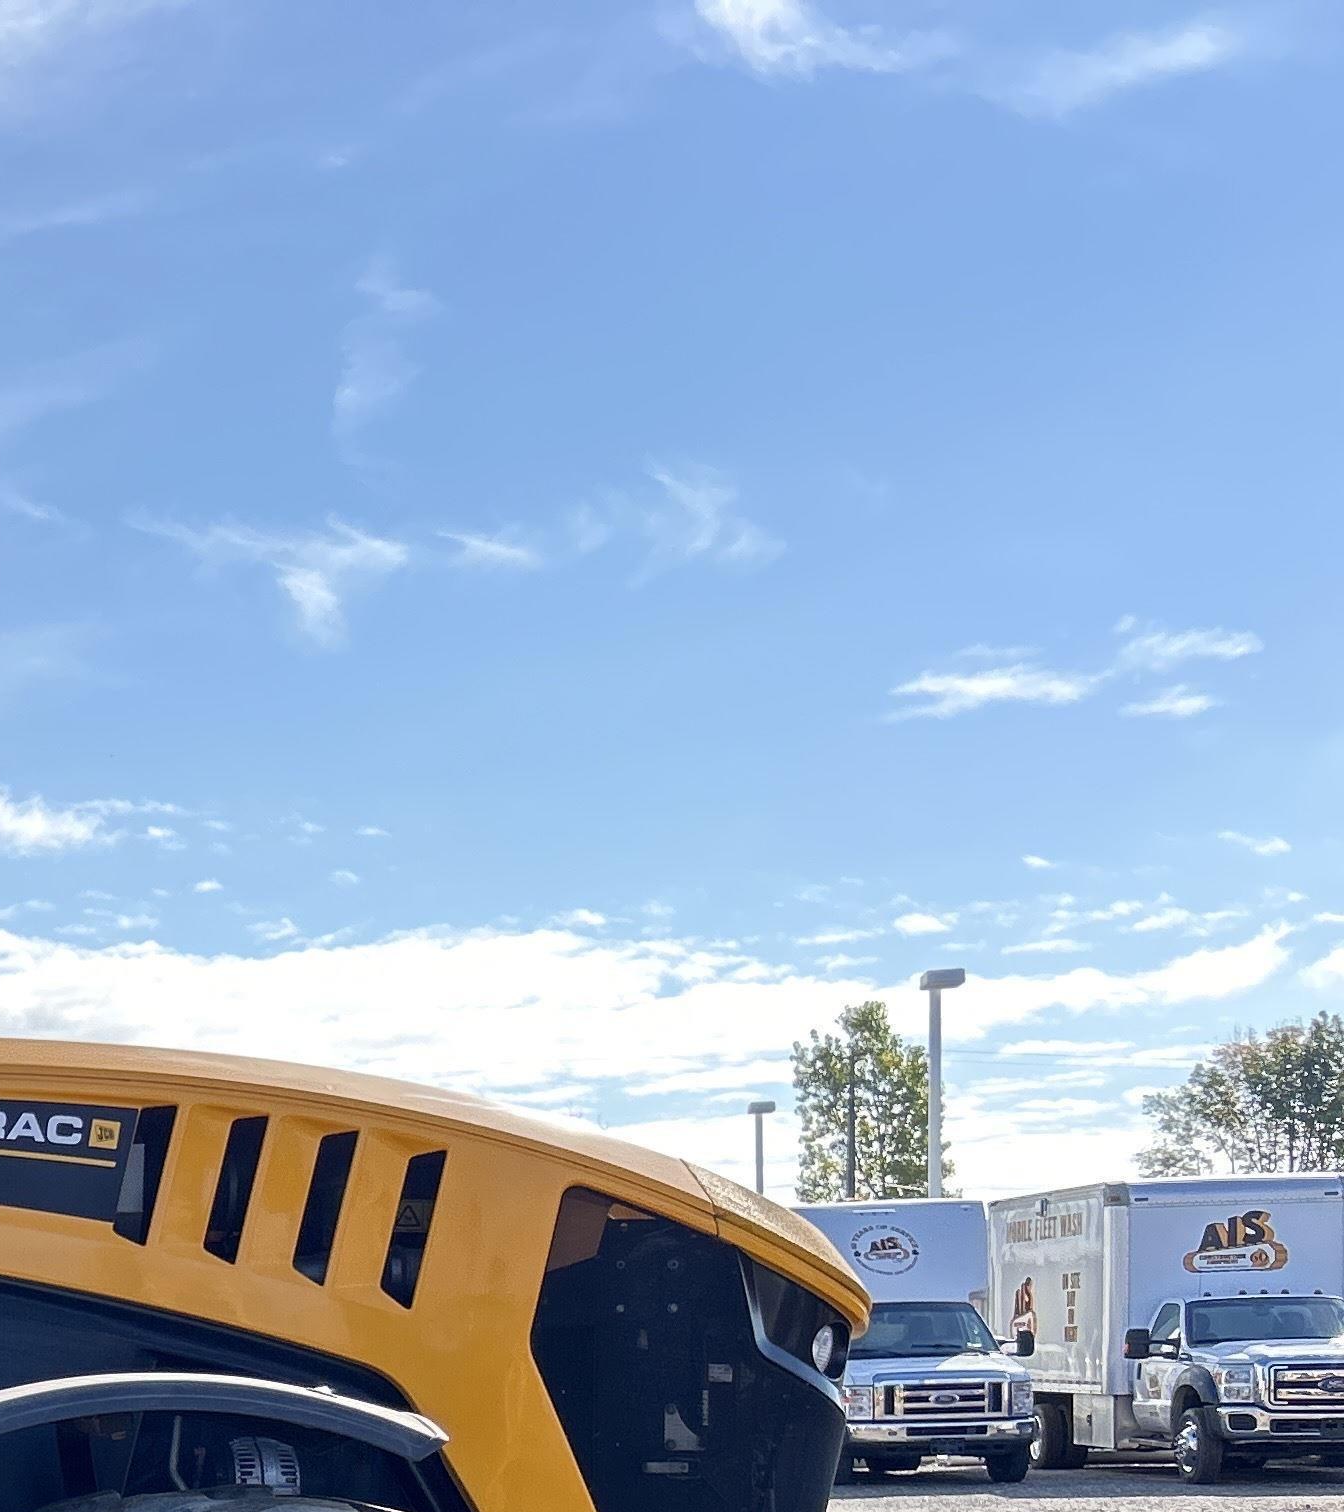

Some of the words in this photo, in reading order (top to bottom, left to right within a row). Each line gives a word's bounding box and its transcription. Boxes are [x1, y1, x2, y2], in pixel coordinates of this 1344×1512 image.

[1035, 1214, 1057, 1241] FLEET
[1060, 1212, 1082, 1237] WASH
[1198, 1210, 1275, 1252] AIS
